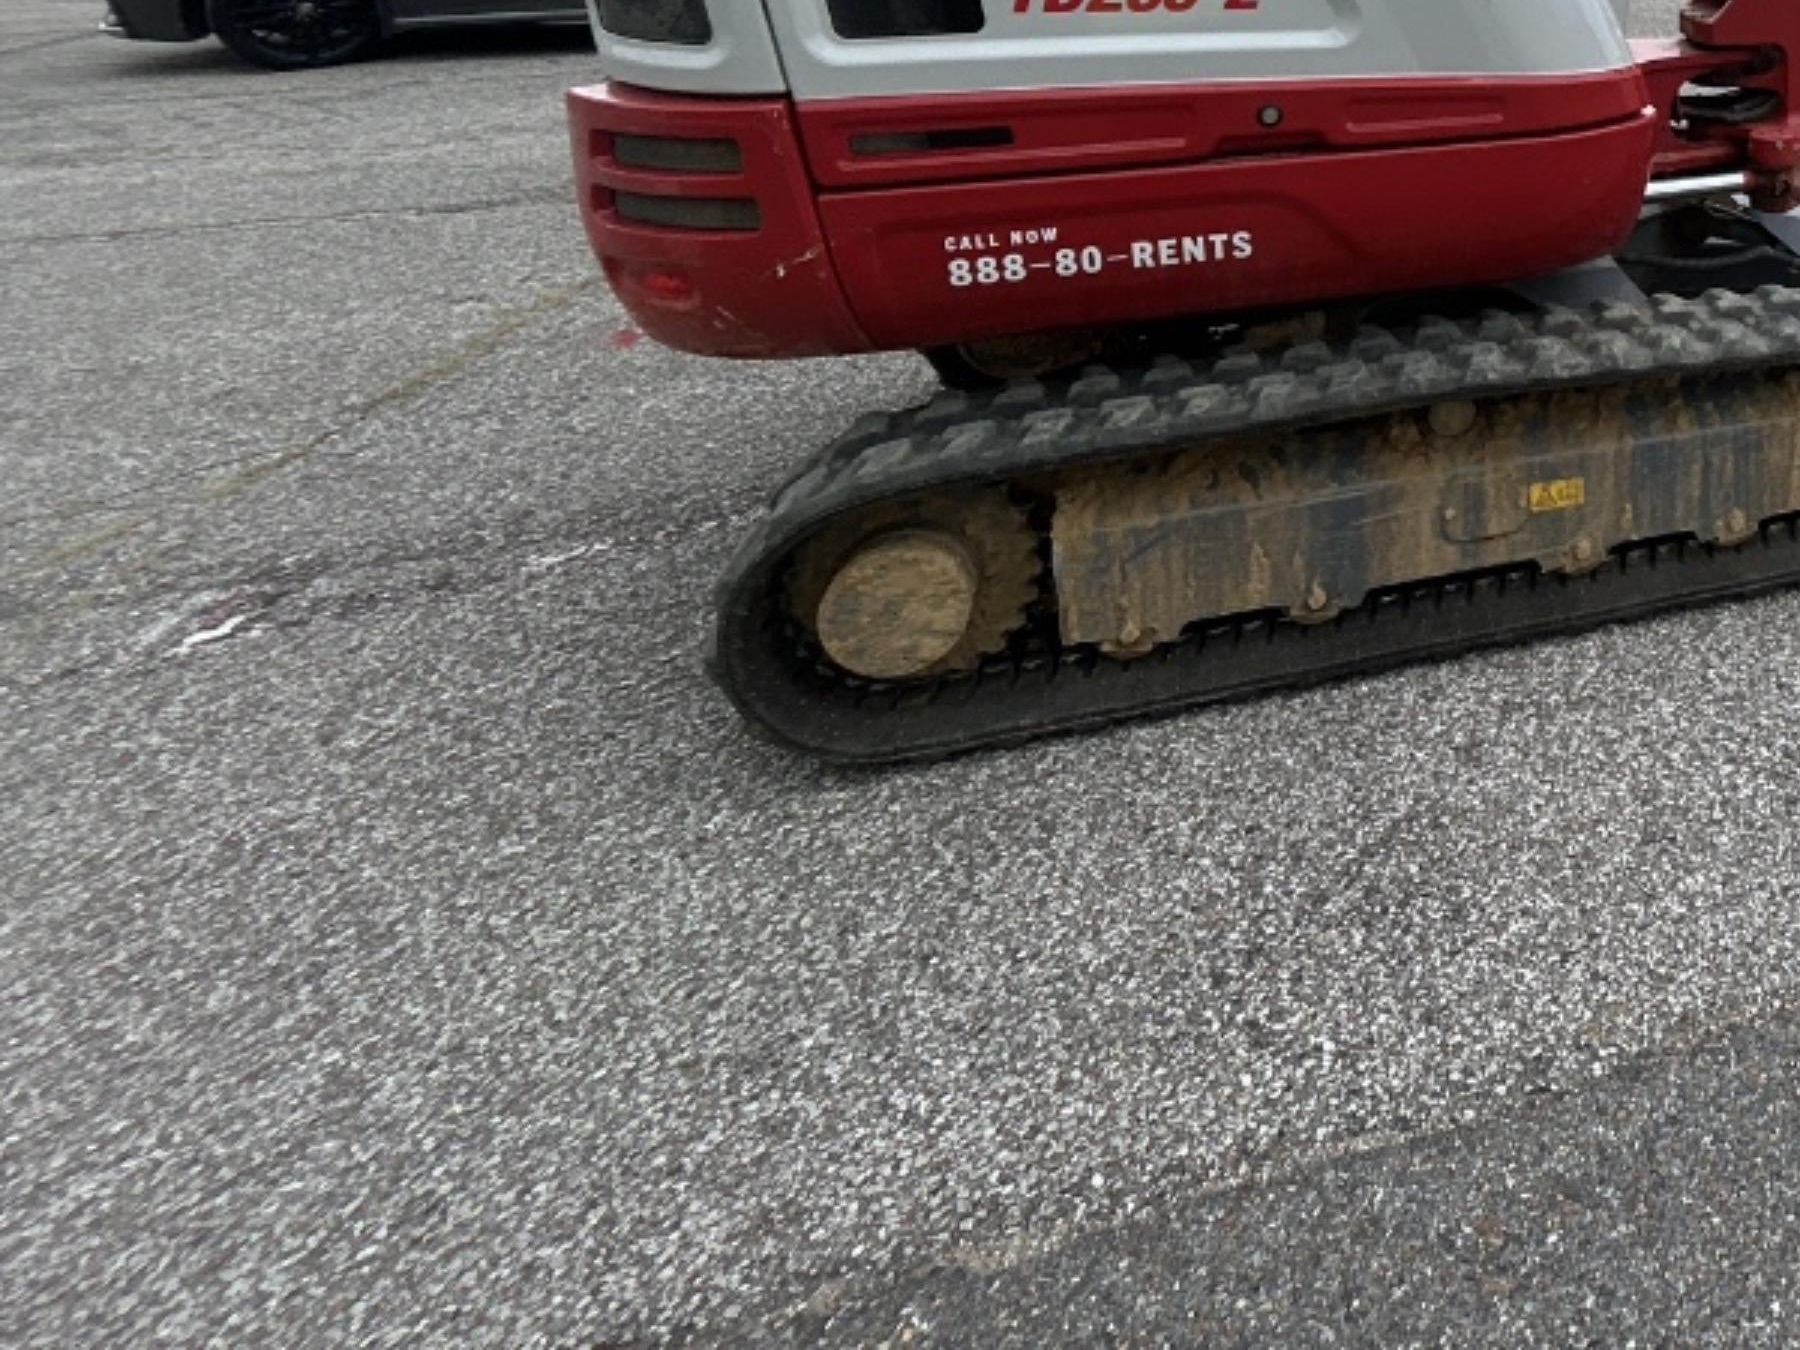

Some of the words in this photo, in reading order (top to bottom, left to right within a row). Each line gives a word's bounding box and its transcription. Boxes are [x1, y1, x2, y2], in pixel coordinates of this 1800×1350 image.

[944, 232, 1000, 252] CALL
[1010, 227, 1058, 247] NOW
[947, 230, 1254, 287] 888-80-RENTS
